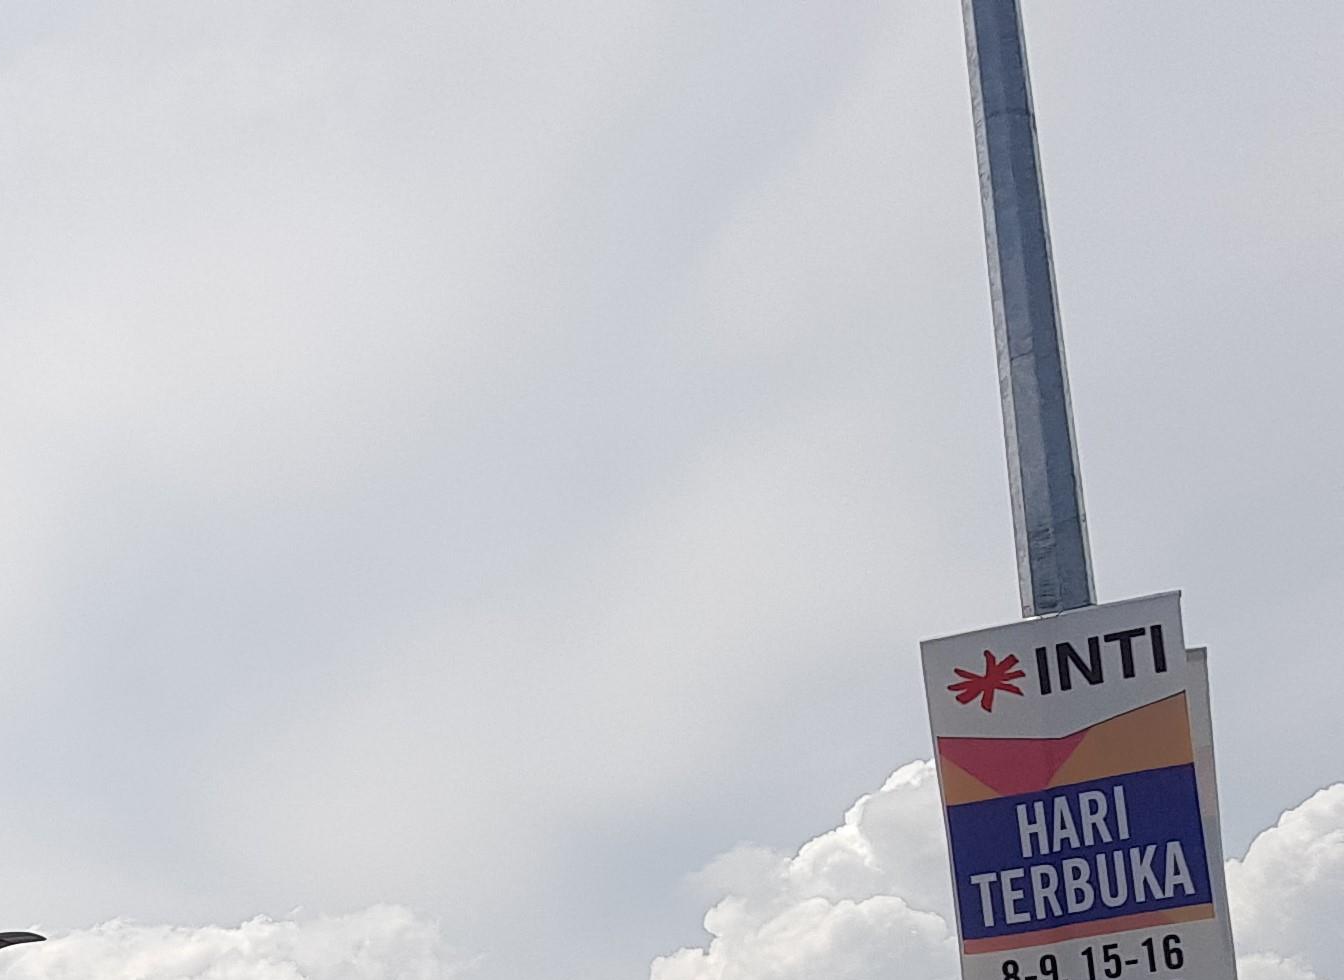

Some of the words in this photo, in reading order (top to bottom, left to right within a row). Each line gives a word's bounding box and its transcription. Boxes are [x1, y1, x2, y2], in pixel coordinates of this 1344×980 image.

[1035, 624, 1168, 696] INTI
[1015, 785, 1132, 858] HARI
[970, 840, 1196, 928] TERBUKA
